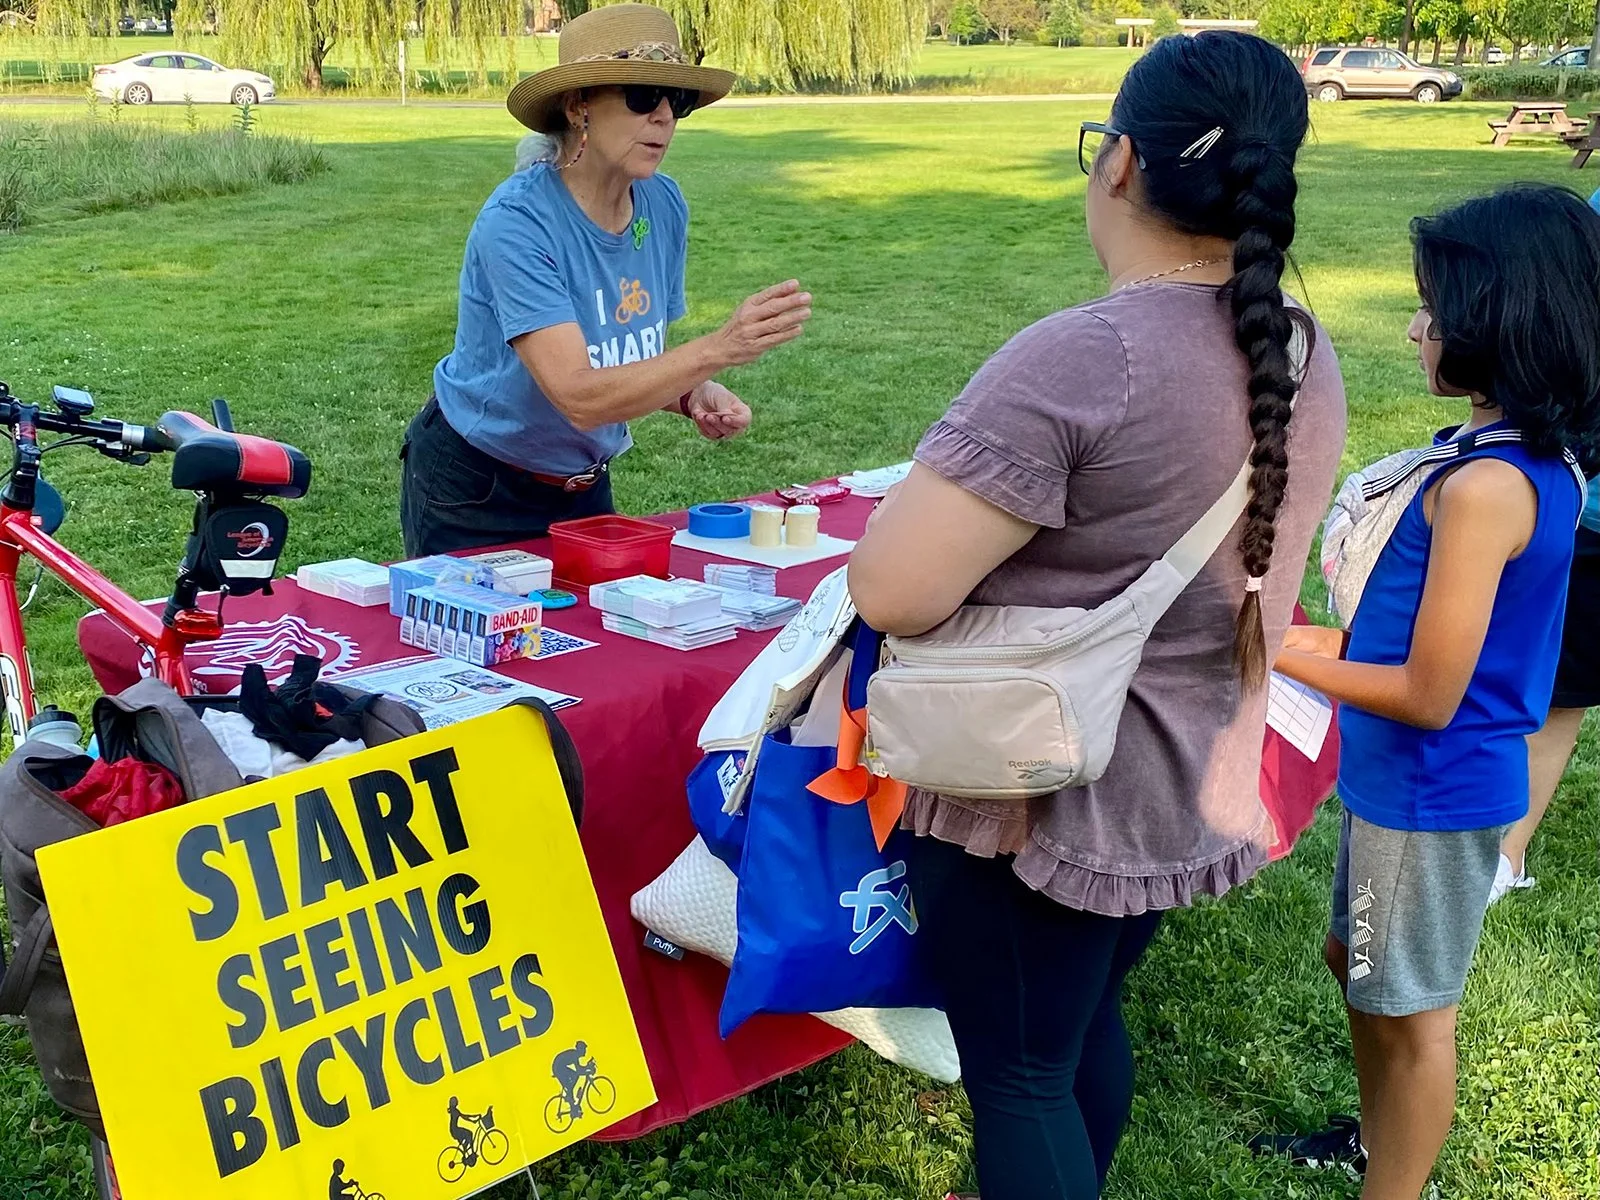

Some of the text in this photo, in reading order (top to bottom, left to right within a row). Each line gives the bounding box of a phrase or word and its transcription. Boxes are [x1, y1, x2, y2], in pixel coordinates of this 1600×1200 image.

[595, 289, 607, 326] I
[587, 318, 664, 369] SMART
[493, 607, 538, 631] BAND-AID
[1008, 758, 1052, 768] Reebok
[175, 746, 470, 942] START
[217, 873, 492, 1048] SEEING
[199, 953, 555, 1179] BICYCLES
